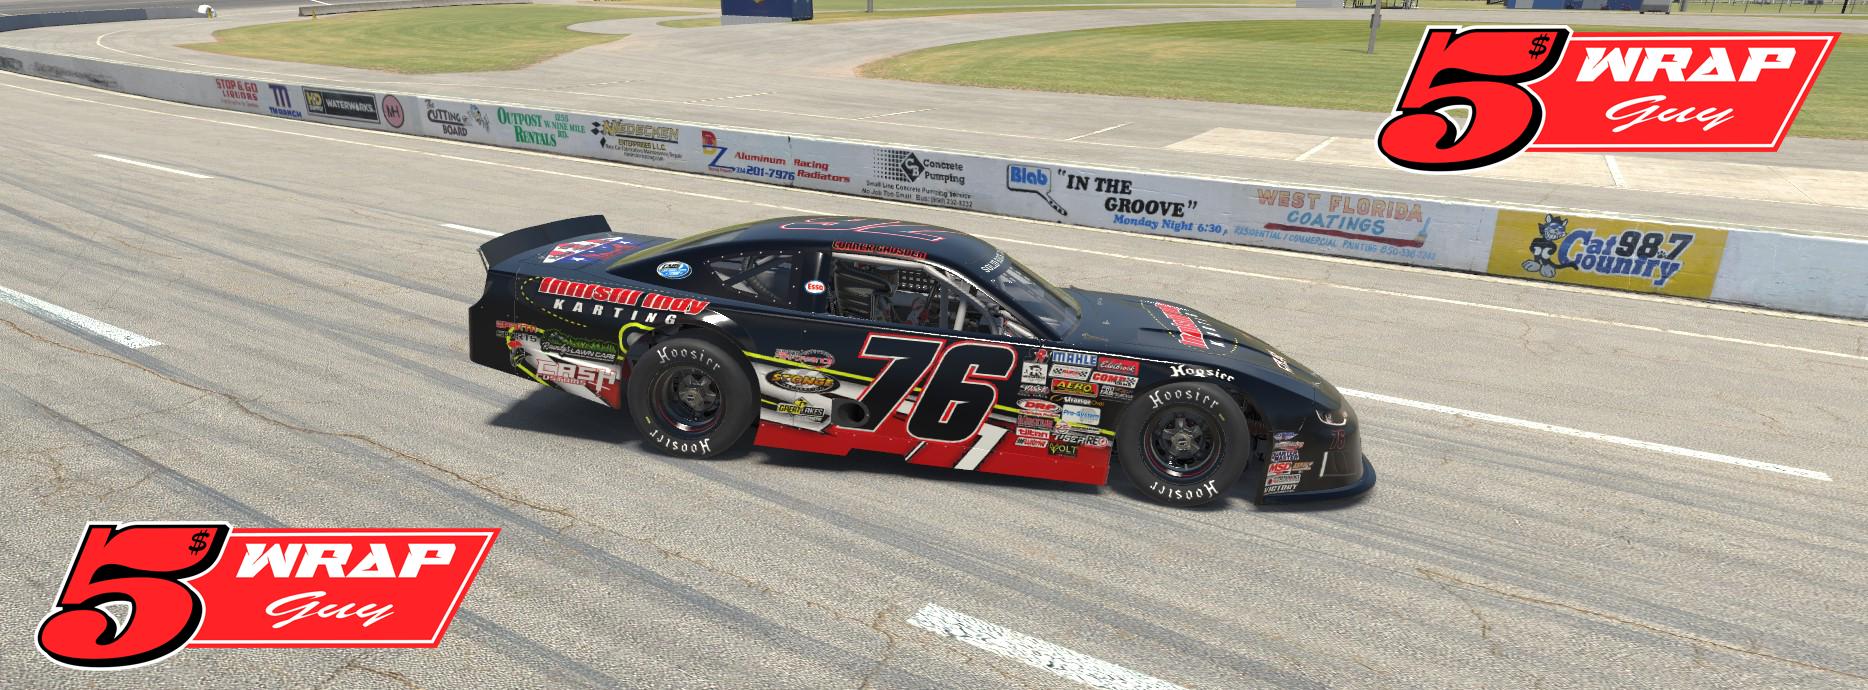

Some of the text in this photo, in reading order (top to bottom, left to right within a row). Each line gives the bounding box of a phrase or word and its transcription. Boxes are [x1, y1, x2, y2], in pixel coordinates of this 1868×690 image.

[216, 79, 236, 90] STOP
[245, 82, 258, 93] GO
[223, 90, 258, 101] LIQUORS
[427, 108, 461, 122] CUTTING
[442, 124, 468, 137] BOARD
[514, 125, 557, 147] RENTALS
[569, 123, 586, 134] MILE
[735, 151, 829, 171] Aluminum Racing
[923, 159, 964, 171] Concrete
[746, 165, 796, 181] 201-7976
[797, 169, 850, 182] Radiators
[924, 171, 965, 185] Pumping
[1010, 166, 1048, 186] Blab
[895, 183, 920, 192] Concrete
[1094, 177, 1133, 195] THE
[1257, 188, 1423, 223] WEST FLORIDA
[1113, 214, 1159, 230] Monday
[1161, 219, 1194, 232] Night
[1286, 210, 1385, 236] COATINGS
[1558, 230, 1617, 264] Cat
[1558, 250, 1680, 287] Country
[807, 283, 824, 291] Esso
[553, 298, 678, 325] KARTING
[570, 347, 595, 357] LAWN
[595, 351, 616, 360] CARE
[657, 346, 720, 371] Hoosier
[1052, 351, 1098, 366] MAHLE
[1092, 371, 1127, 383] COMP
[1170, 364, 1235, 382] Hoosier
[856, 331, 1018, 444] 76
[1057, 381, 1092, 393] AERO
[1024, 401, 1057, 411] DRP
[1149, 389, 1219, 409] Hoosier
[649, 429, 711, 454] Hoosier
[1150, 479, 1219, 500] Hoosier
